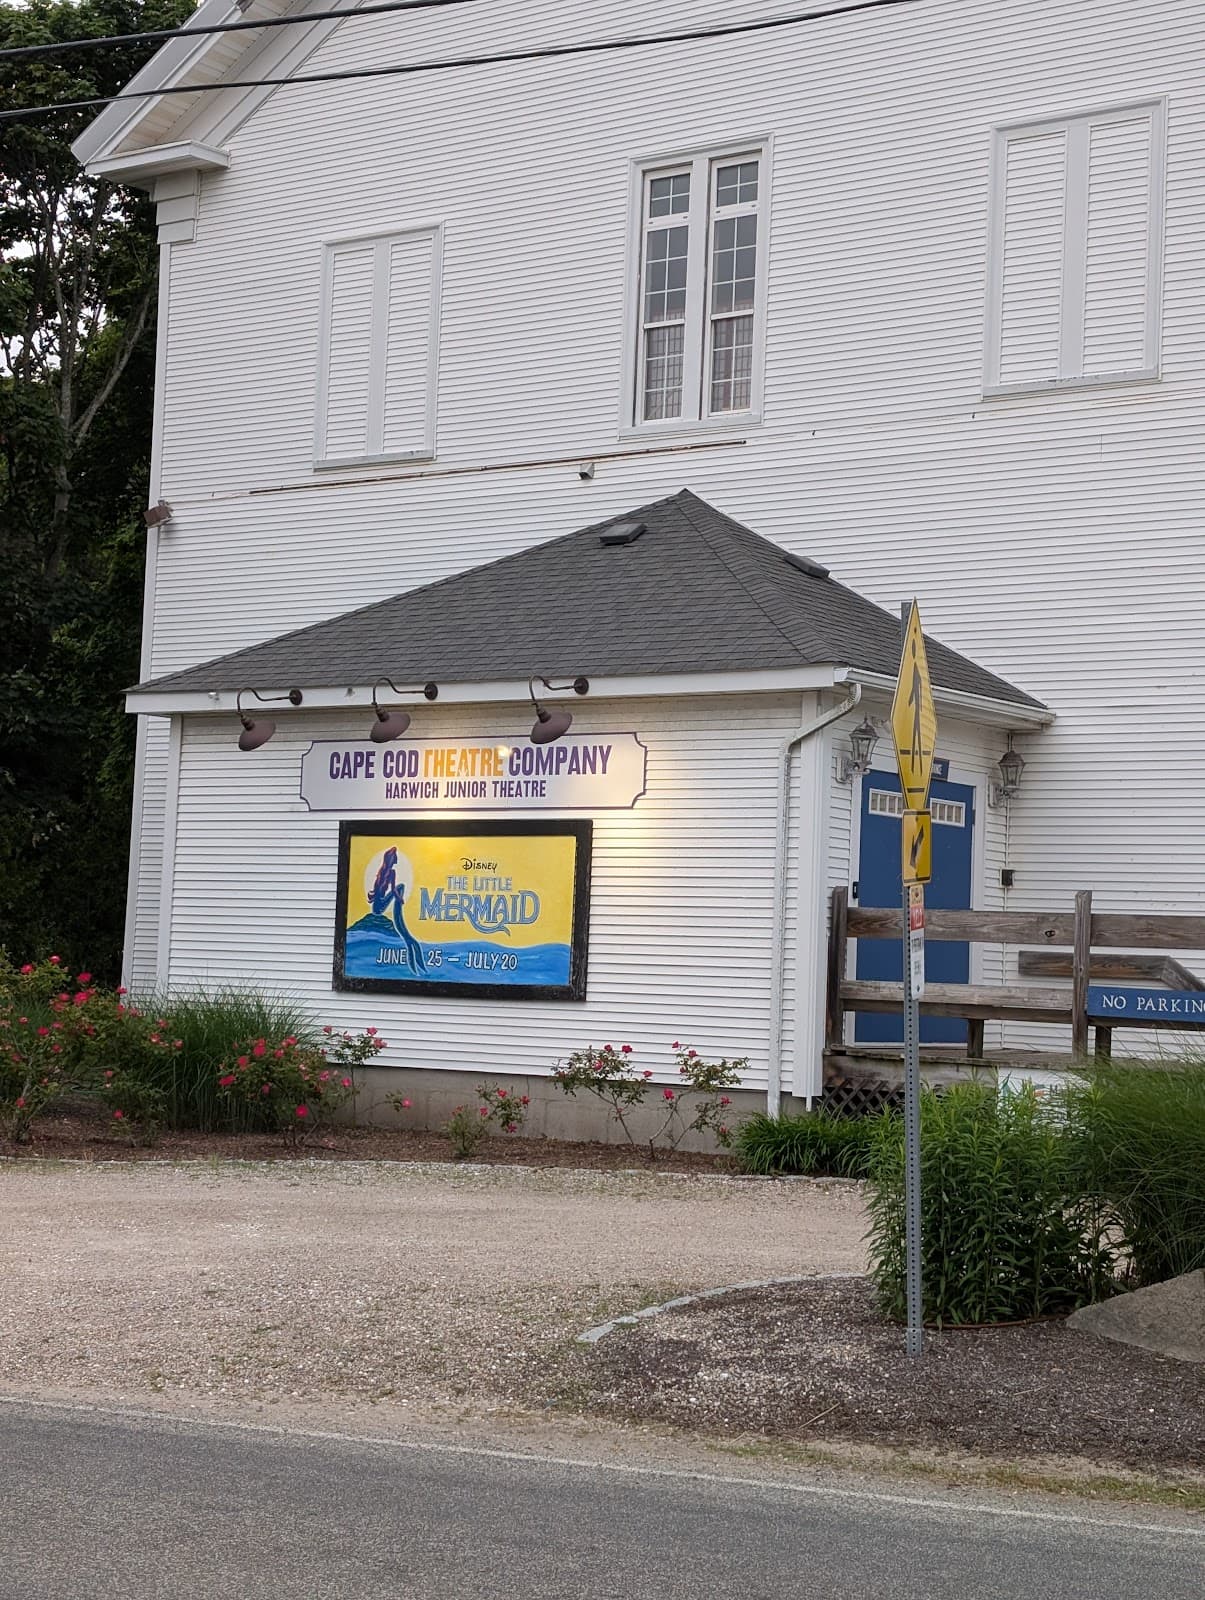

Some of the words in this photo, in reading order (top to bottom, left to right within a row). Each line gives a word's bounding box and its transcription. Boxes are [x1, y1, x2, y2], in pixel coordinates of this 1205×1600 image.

[329, 751, 376, 779] CAPE
[383, 750, 419, 779] COD
[423, 747, 504, 778] THEATRE
[508, 745, 612, 776] COMPANY
[385, 781, 439, 799] HARWICH
[444, 780, 487, 798] JUNIOR
[492, 780, 547, 798] THEATRE
[447, 875, 468, 891] THE
[473, 876, 512, 891] LITTLE
[418, 888, 541, 936] MERMAID
[376, 948, 407, 964] JUNE
[427, 950, 443, 966] 25
[465, 951, 500, 970] JULY
[501, 954, 518, 970] 20
[1102, 994, 1127, 1010] NO
